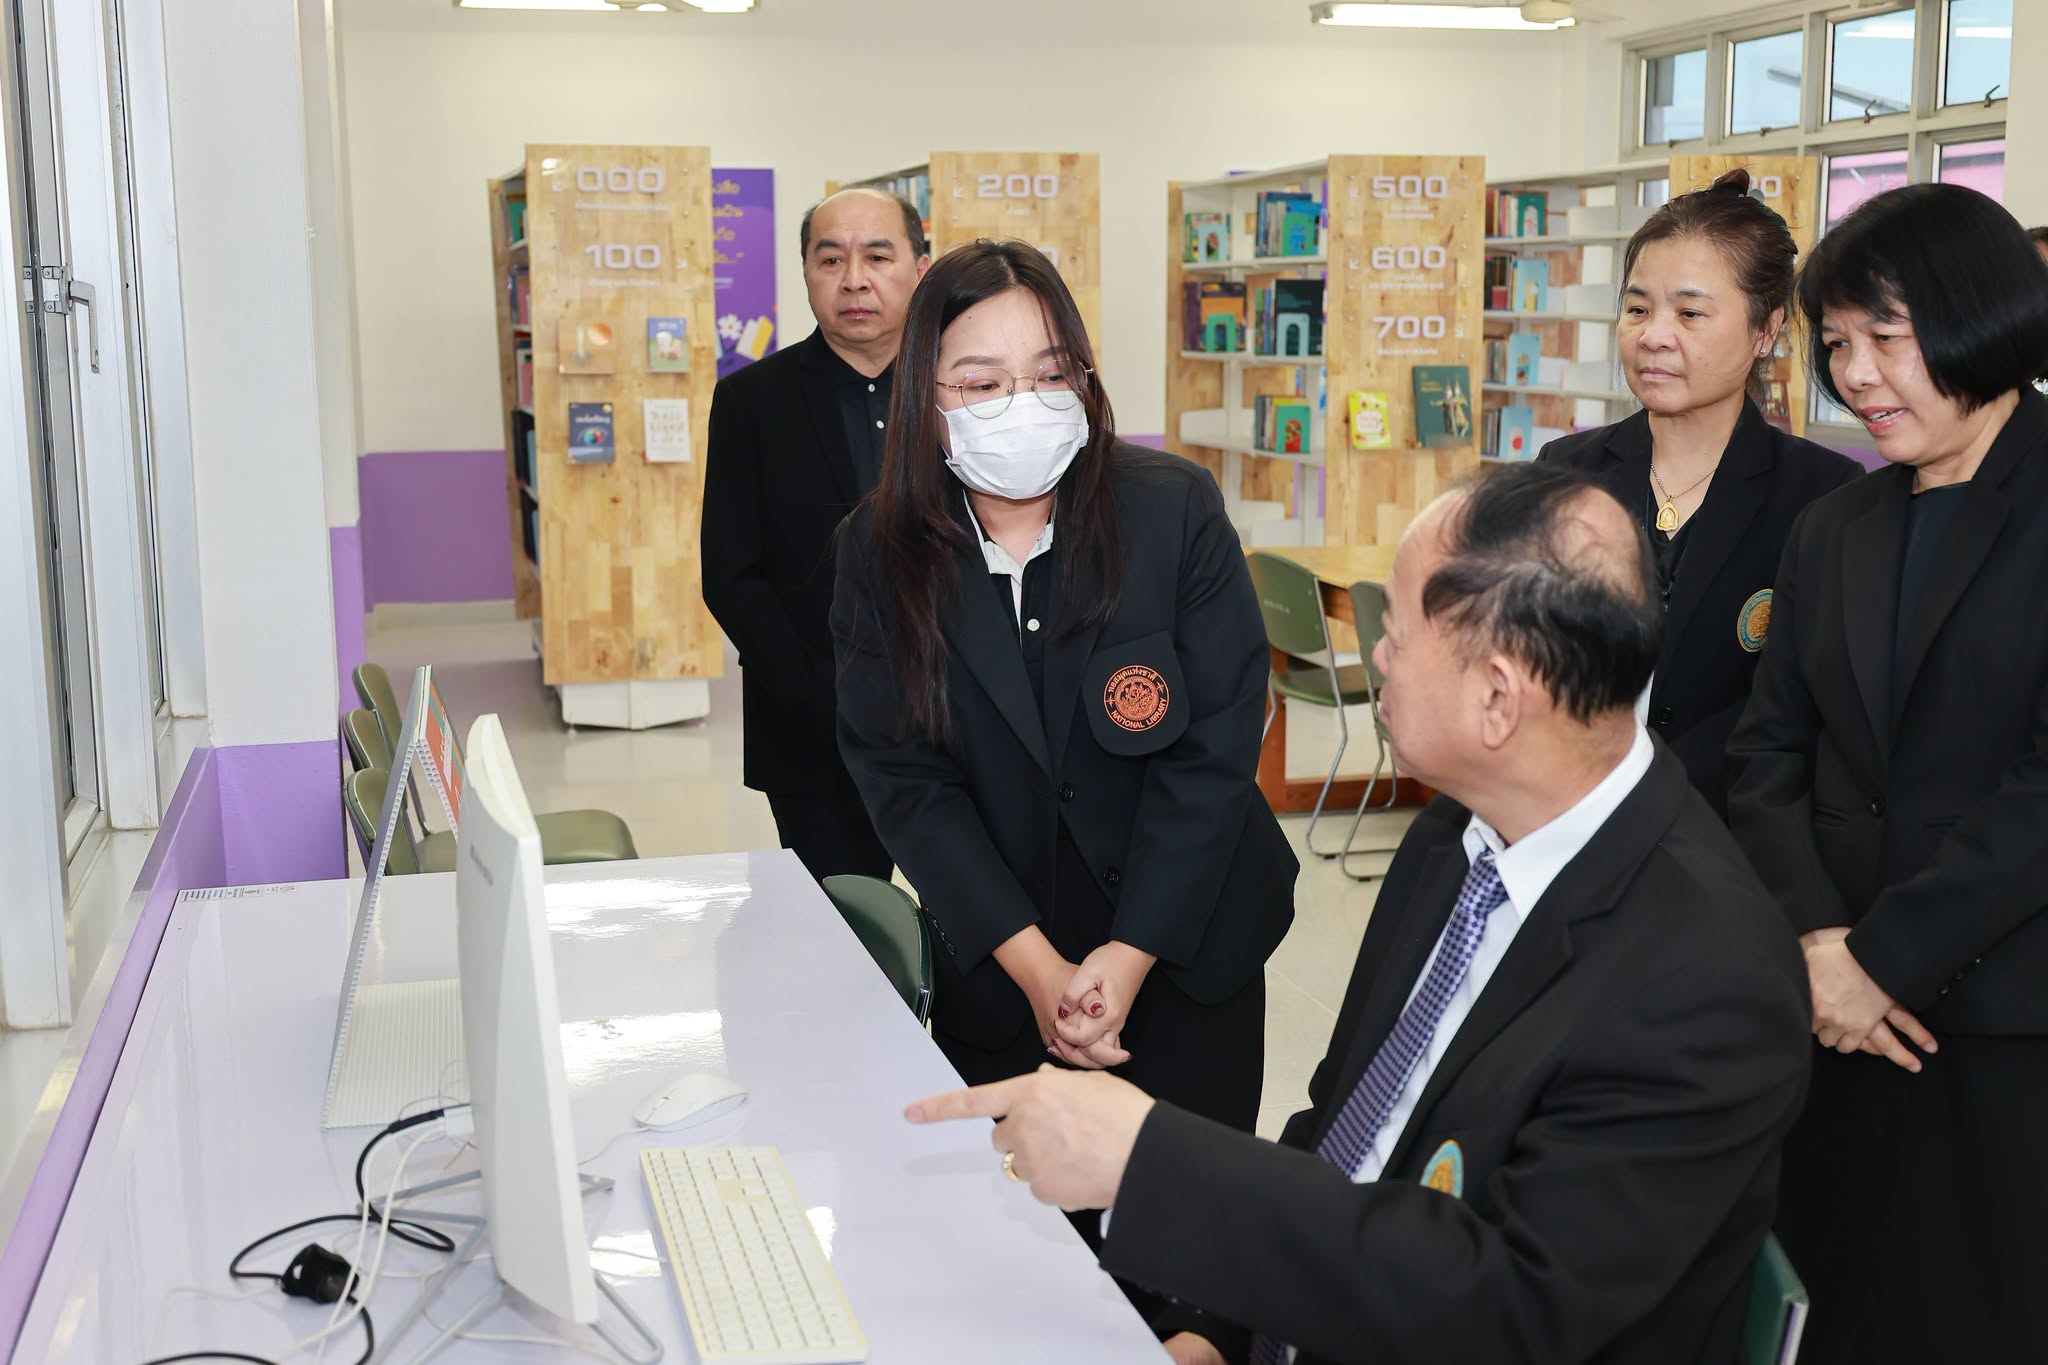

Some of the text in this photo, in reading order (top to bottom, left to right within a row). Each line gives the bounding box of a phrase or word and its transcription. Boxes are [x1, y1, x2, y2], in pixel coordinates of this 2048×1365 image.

[576, 166, 665, 192] 000
[977, 174, 1059, 199] 200
[1372, 175, 1448, 199] 500
[584, 243, 662, 270] 100
[1371, 246, 1447, 270] 600
[1372, 315, 1446, 340] 700
[1111, 697, 1167, 728] NATIONAL LIBRARY
